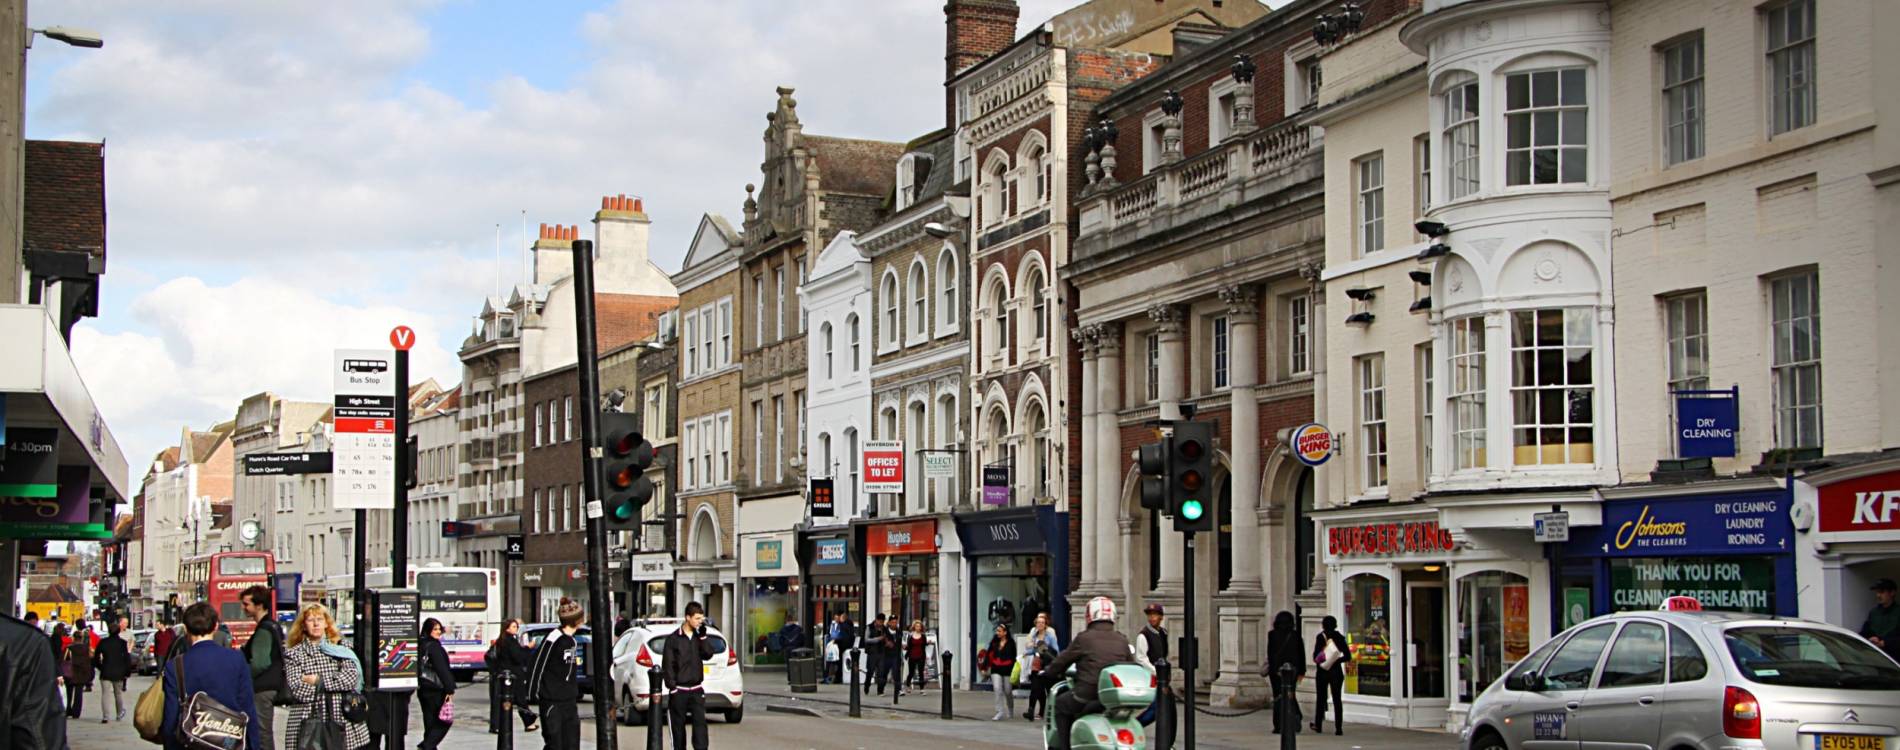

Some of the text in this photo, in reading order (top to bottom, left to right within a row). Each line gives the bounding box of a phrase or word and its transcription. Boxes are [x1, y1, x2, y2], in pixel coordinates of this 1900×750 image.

[395, 328, 410, 346] V
[350, 376, 381, 385] Bus Stop
[349, 398, 380, 406] High Street
[1696, 418, 1716, 428] DRY
[1299, 432, 1330, 444] BURGER
[1682, 428, 1732, 439] CLEANING
[10, 441, 53, 454] 4.30pm
[1299, 440, 1331, 455] KING
[867, 457, 899, 467] OFFICES
[926, 456, 952, 465] SELECT
[264, 466, 285, 474] Quarter
[871, 467, 896, 477] TO LET
[1715, 501, 1777, 515] DRY CLEANING
[1851, 489, 1900, 524] KF
[1615, 505, 1687, 550] Johnsons
[1726, 518, 1765, 530] LAUNDRY
[990, 523, 1020, 541] MOSS
[1328, 520, 1455, 556] BURGER KING
[887, 530, 911, 547] Hughes
[1637, 537, 1687, 547] THE CLEANERS
[1727, 533, 1766, 546] IRONING
[821, 544, 844, 560] GREGGS
[1635, 563, 1742, 582] THANK YOU FOR
[440, 601, 455, 609] First
[1673, 600, 1699, 611] TAXI
[191, 711, 243, 737] Yankees
[1535, 713, 1560, 723] SWAN
[1823, 735, 1881, 750] EY05 UAE
